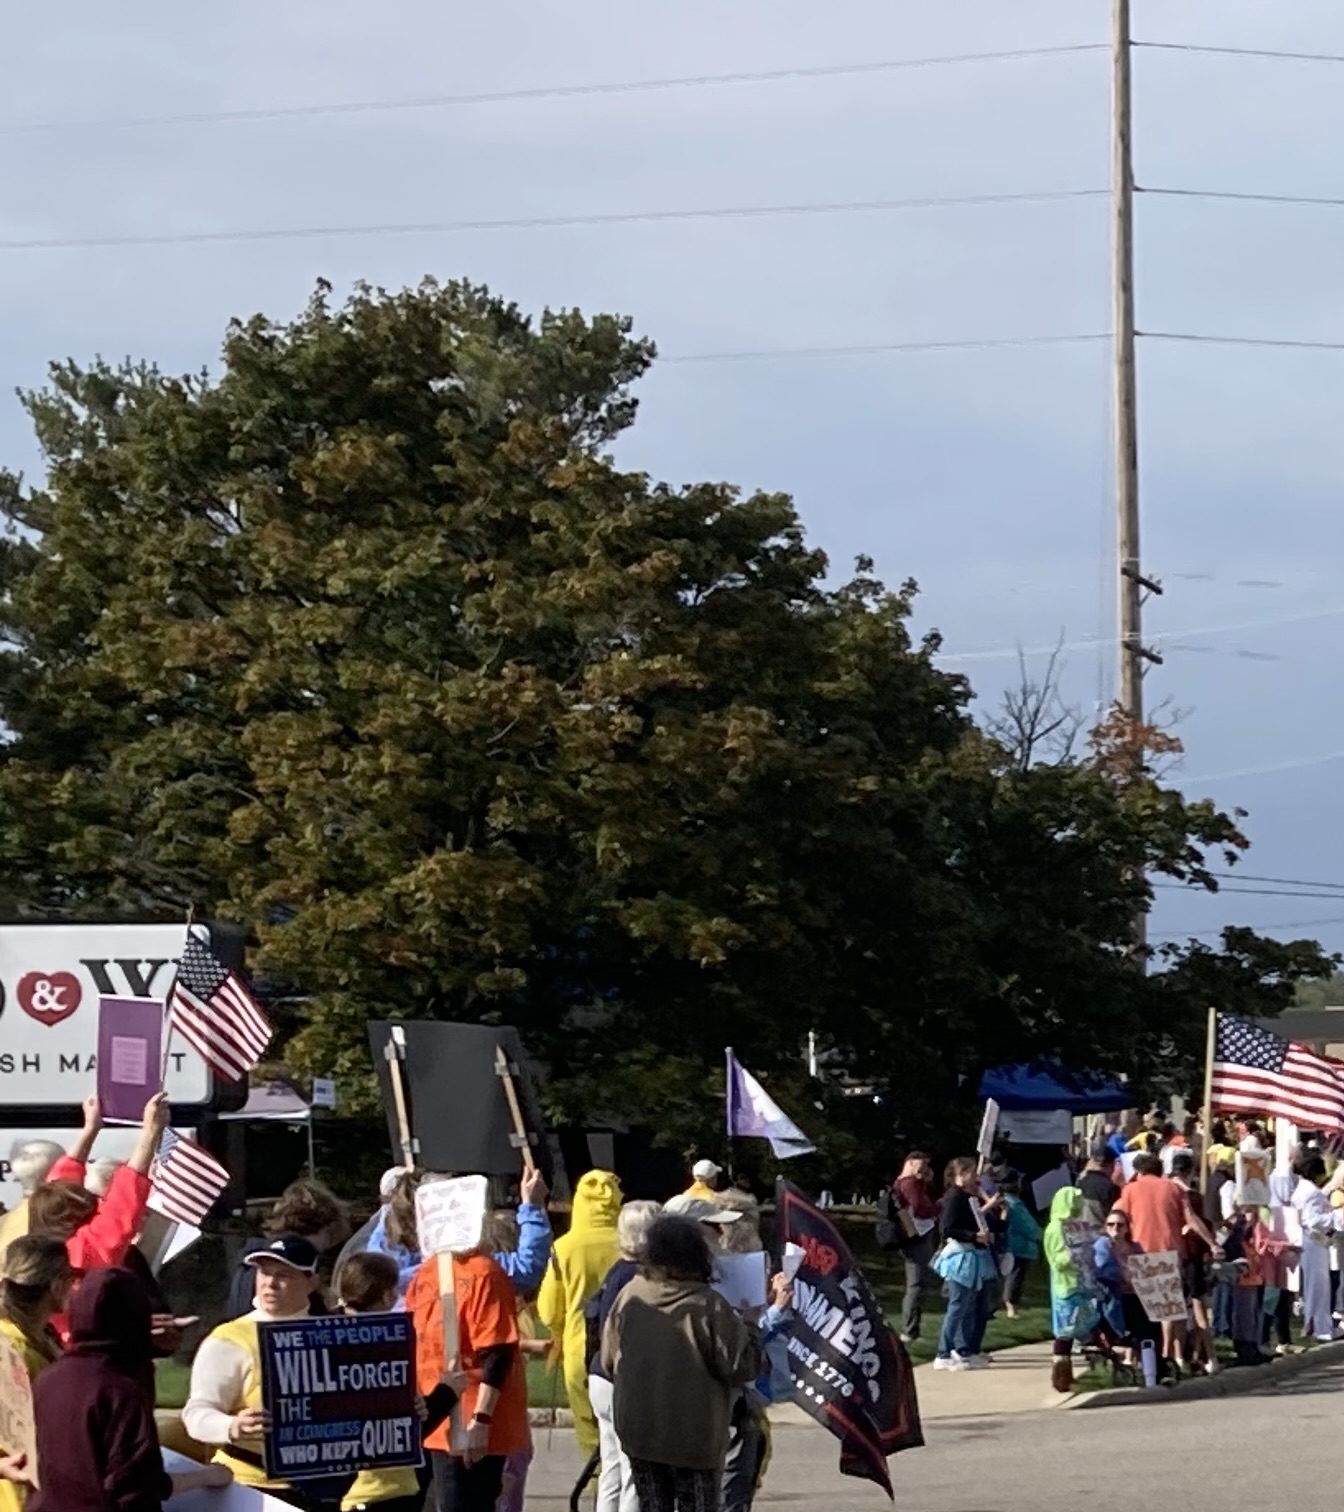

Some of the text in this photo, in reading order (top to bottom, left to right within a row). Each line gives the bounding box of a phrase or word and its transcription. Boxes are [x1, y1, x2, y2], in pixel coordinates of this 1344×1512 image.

[59, 1053, 187, 1074] MAT
[273, 1323, 407, 1348] WE THE PEOPLE
[273, 1347, 410, 1395] WILL FORGET
[814, 1361, 855, 1398] 1776
[276, 1396, 313, 1424] THE
[279, 1416, 412, 1464] WHO KEPT QUIET
[296, 1420, 361, 1441] CONGRESS
